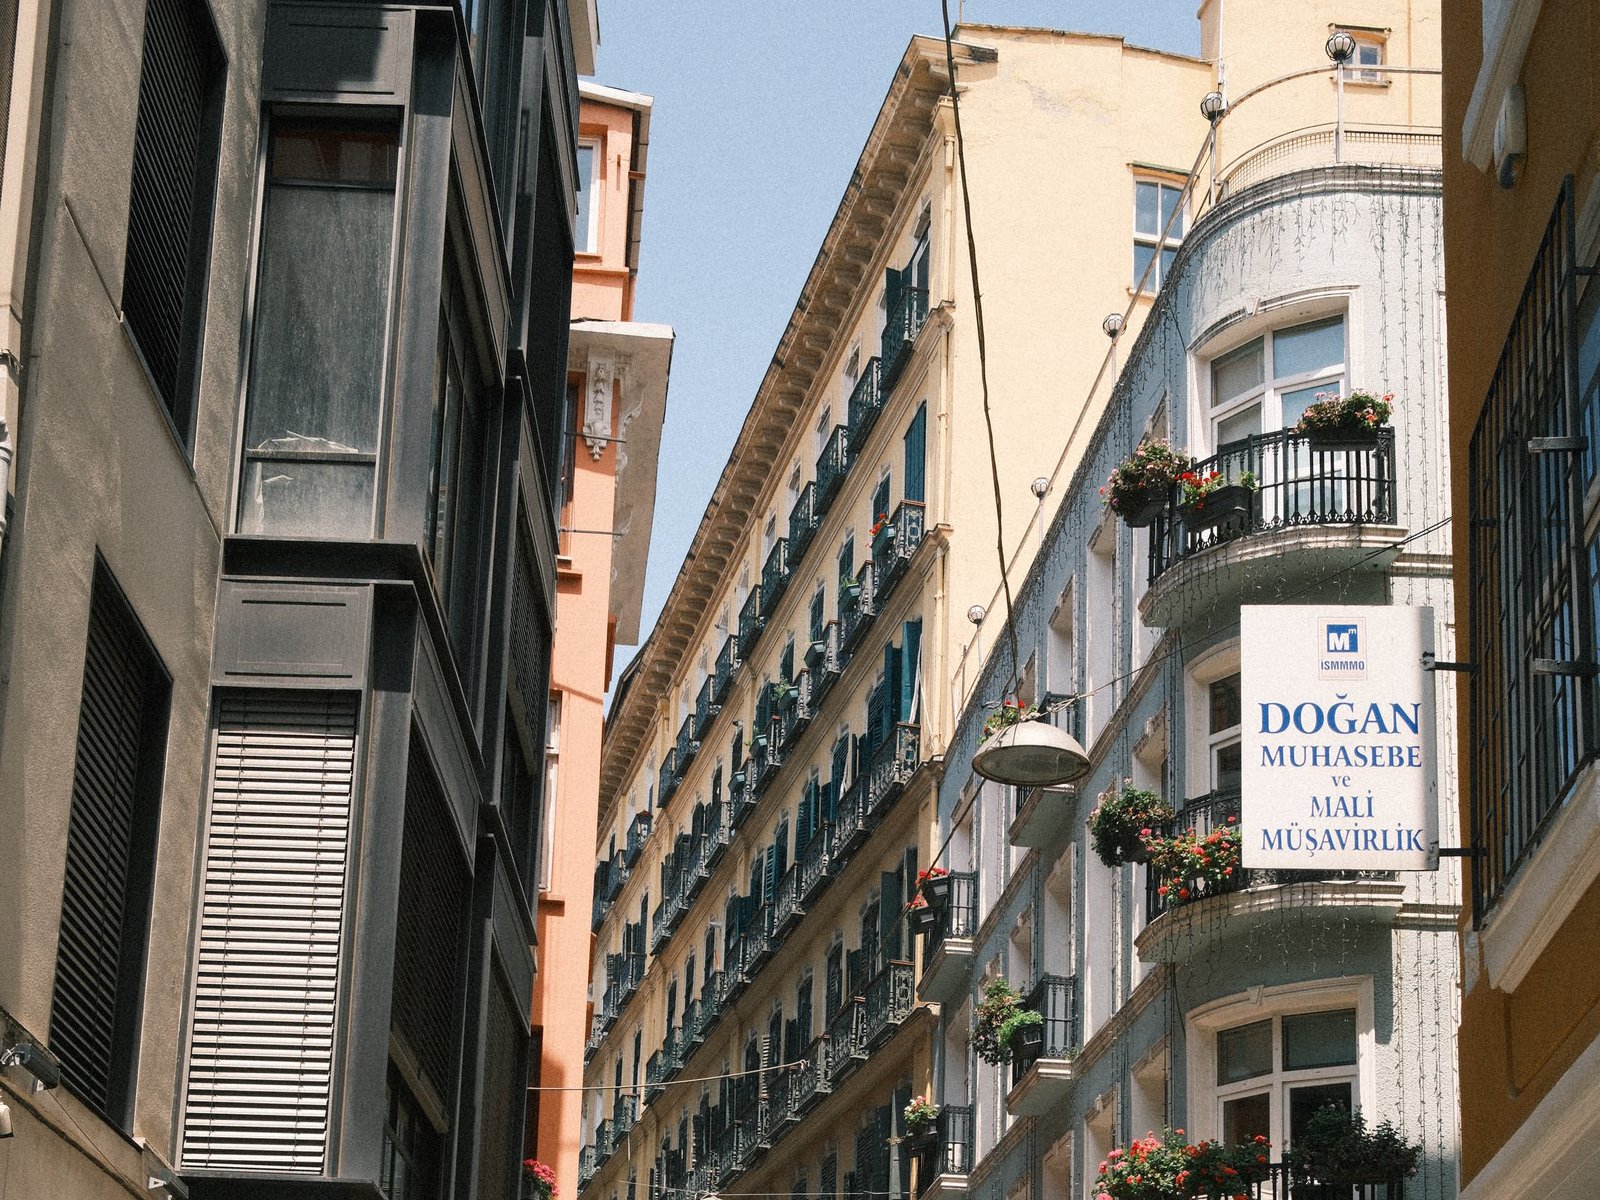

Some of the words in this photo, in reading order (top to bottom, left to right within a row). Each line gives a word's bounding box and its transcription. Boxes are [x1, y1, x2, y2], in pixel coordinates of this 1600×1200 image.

[1257, 692, 1422, 735] DOĞAN
[1260, 745, 1423, 768] MUHASEBE
[1331, 774, 1351, 788] ve
[1309, 790, 1374, 818] MALİ
[1261, 822, 1425, 857] MÜŞAVİRLİK
